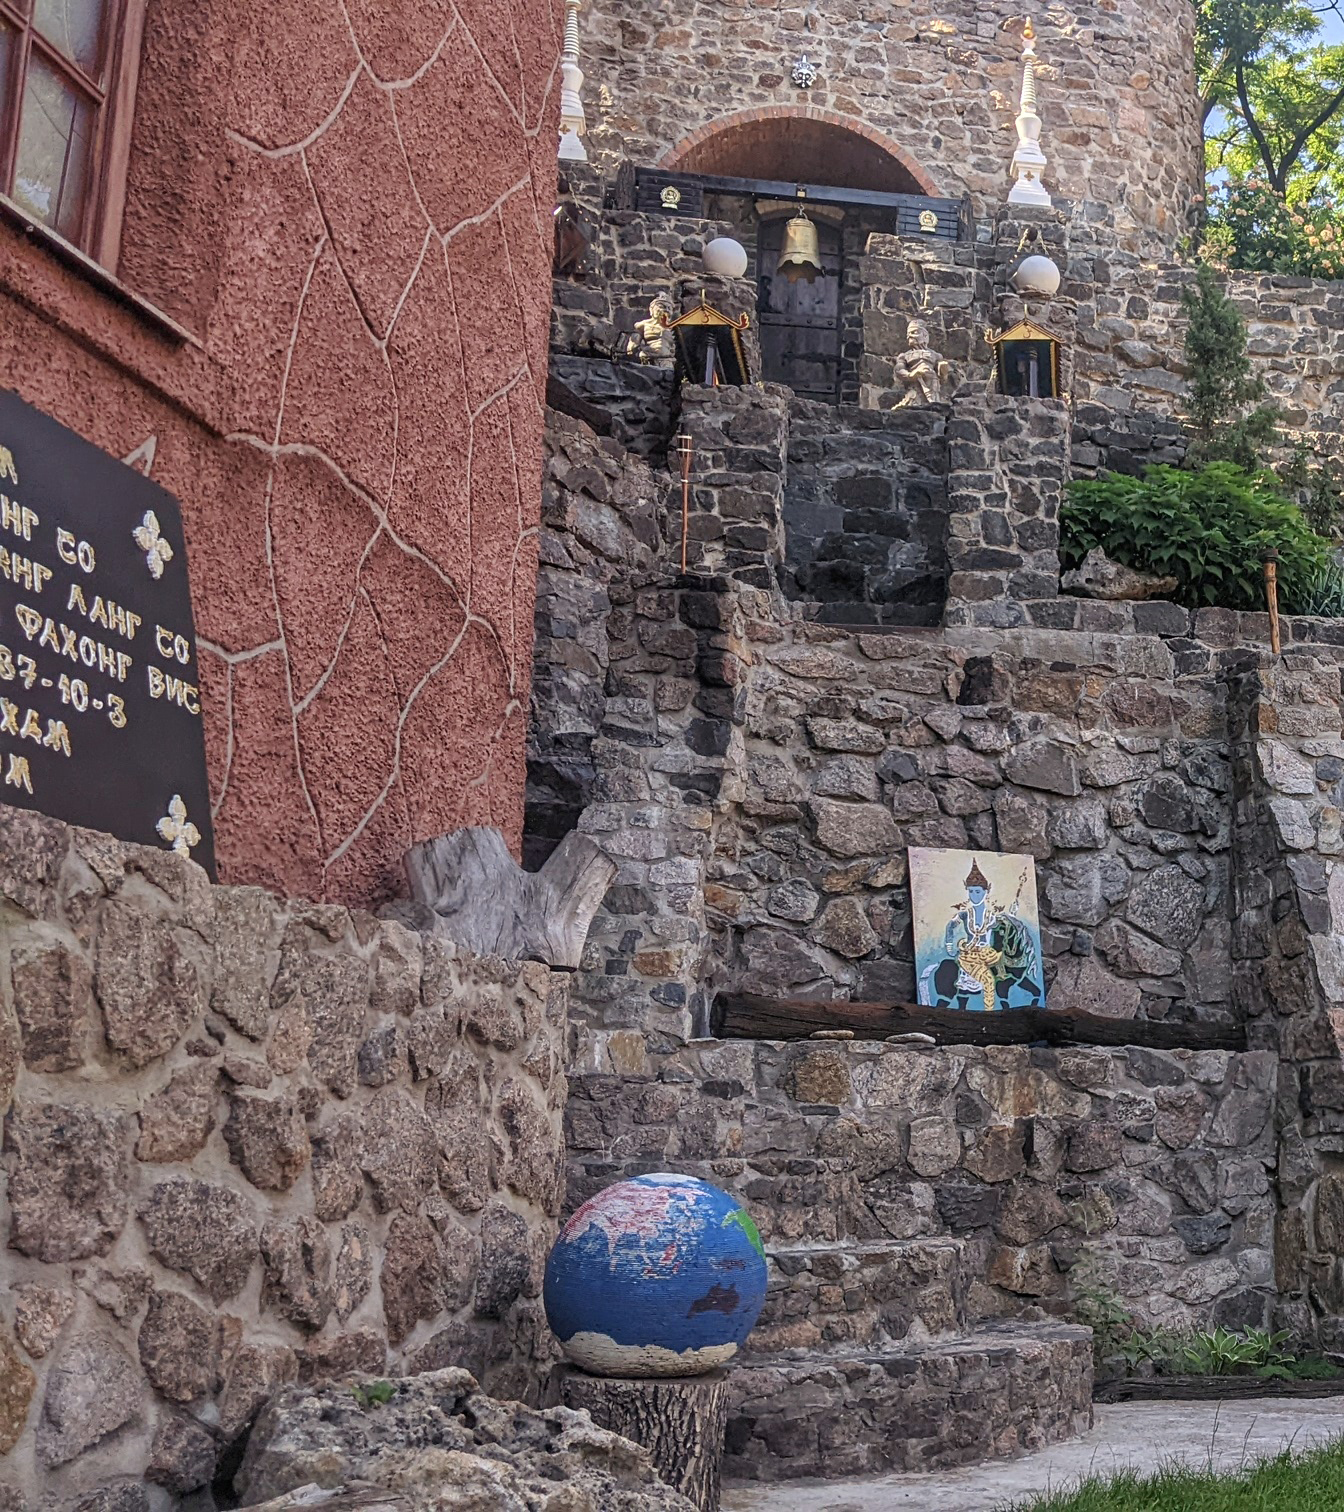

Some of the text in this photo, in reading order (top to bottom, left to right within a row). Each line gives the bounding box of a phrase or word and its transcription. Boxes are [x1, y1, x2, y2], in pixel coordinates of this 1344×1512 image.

[57, 526, 96, 573] СО
[15, 603, 201, 715] ФАХОНГ ВИС
[67, 584, 142, 640] ЛАНГ
[156, 624, 190, 665] СО
